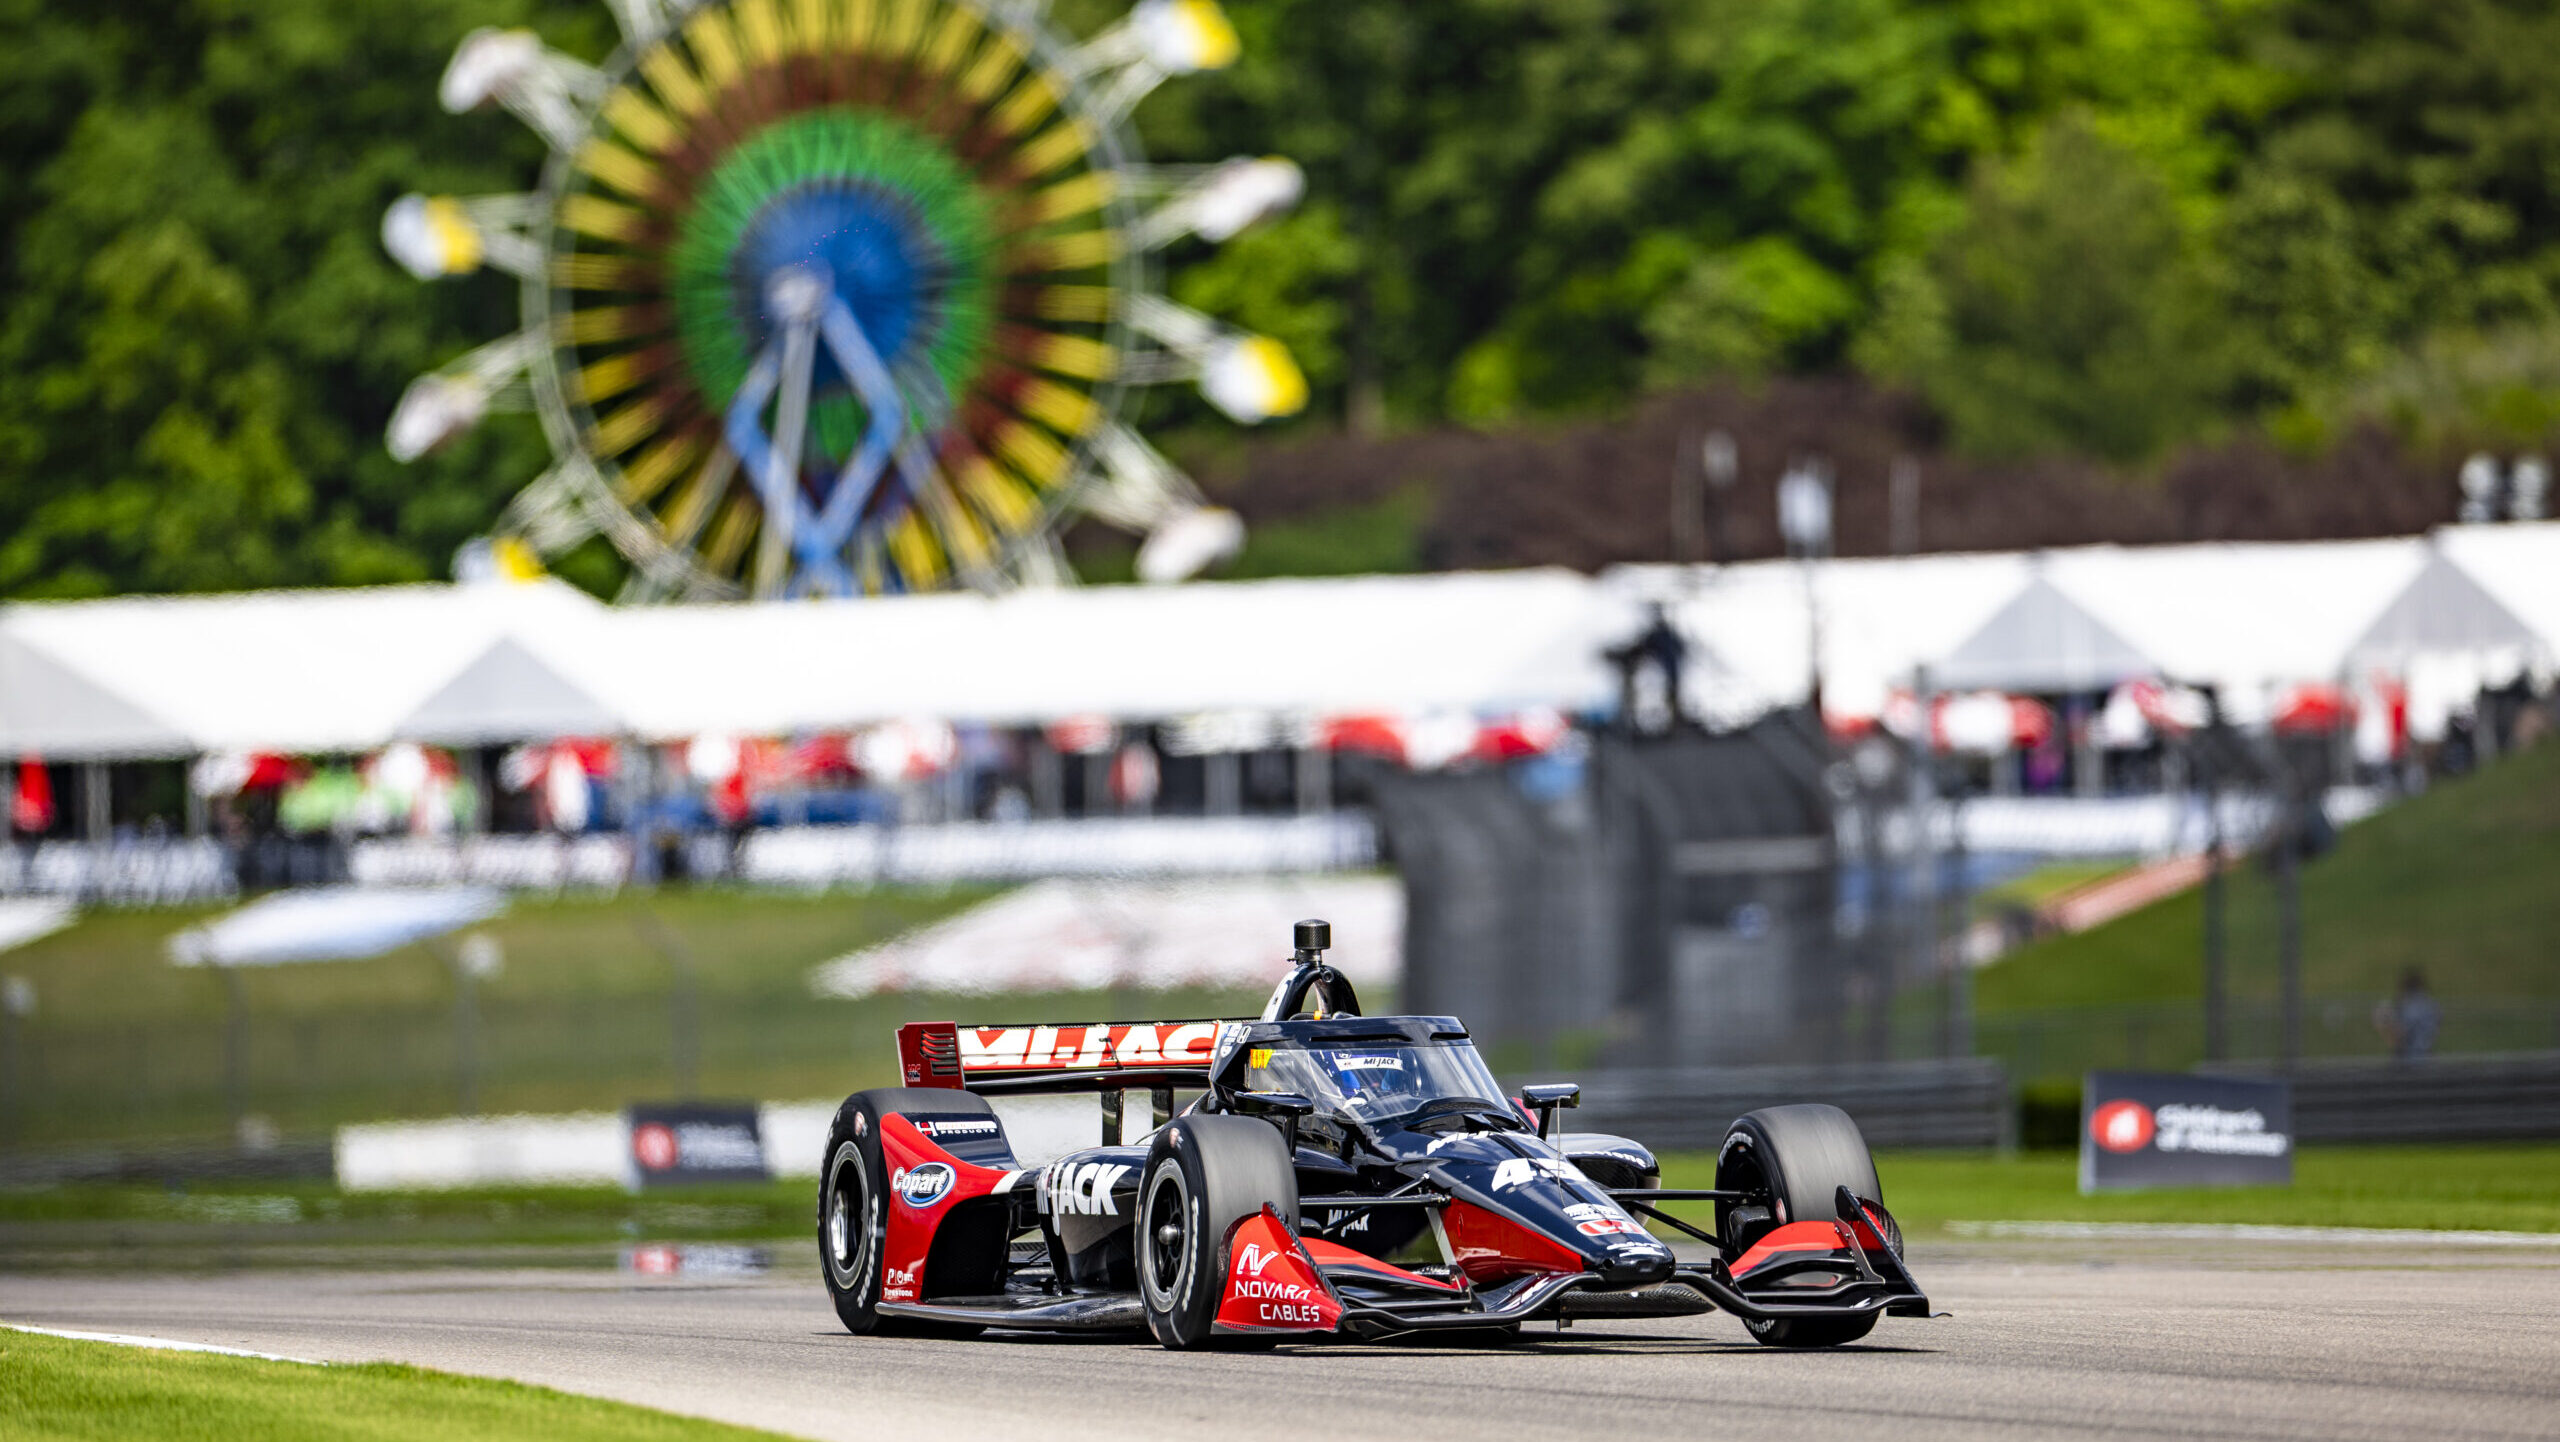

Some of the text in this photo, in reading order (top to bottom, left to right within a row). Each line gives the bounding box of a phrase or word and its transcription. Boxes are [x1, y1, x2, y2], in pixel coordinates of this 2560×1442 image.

[957, 1024, 1221, 1068] MI-JAC
[892, 1166, 950, 1198] Copart
[1235, 1280, 1312, 1300] NOVARA
[1260, 1303, 1321, 1322] CABLES
